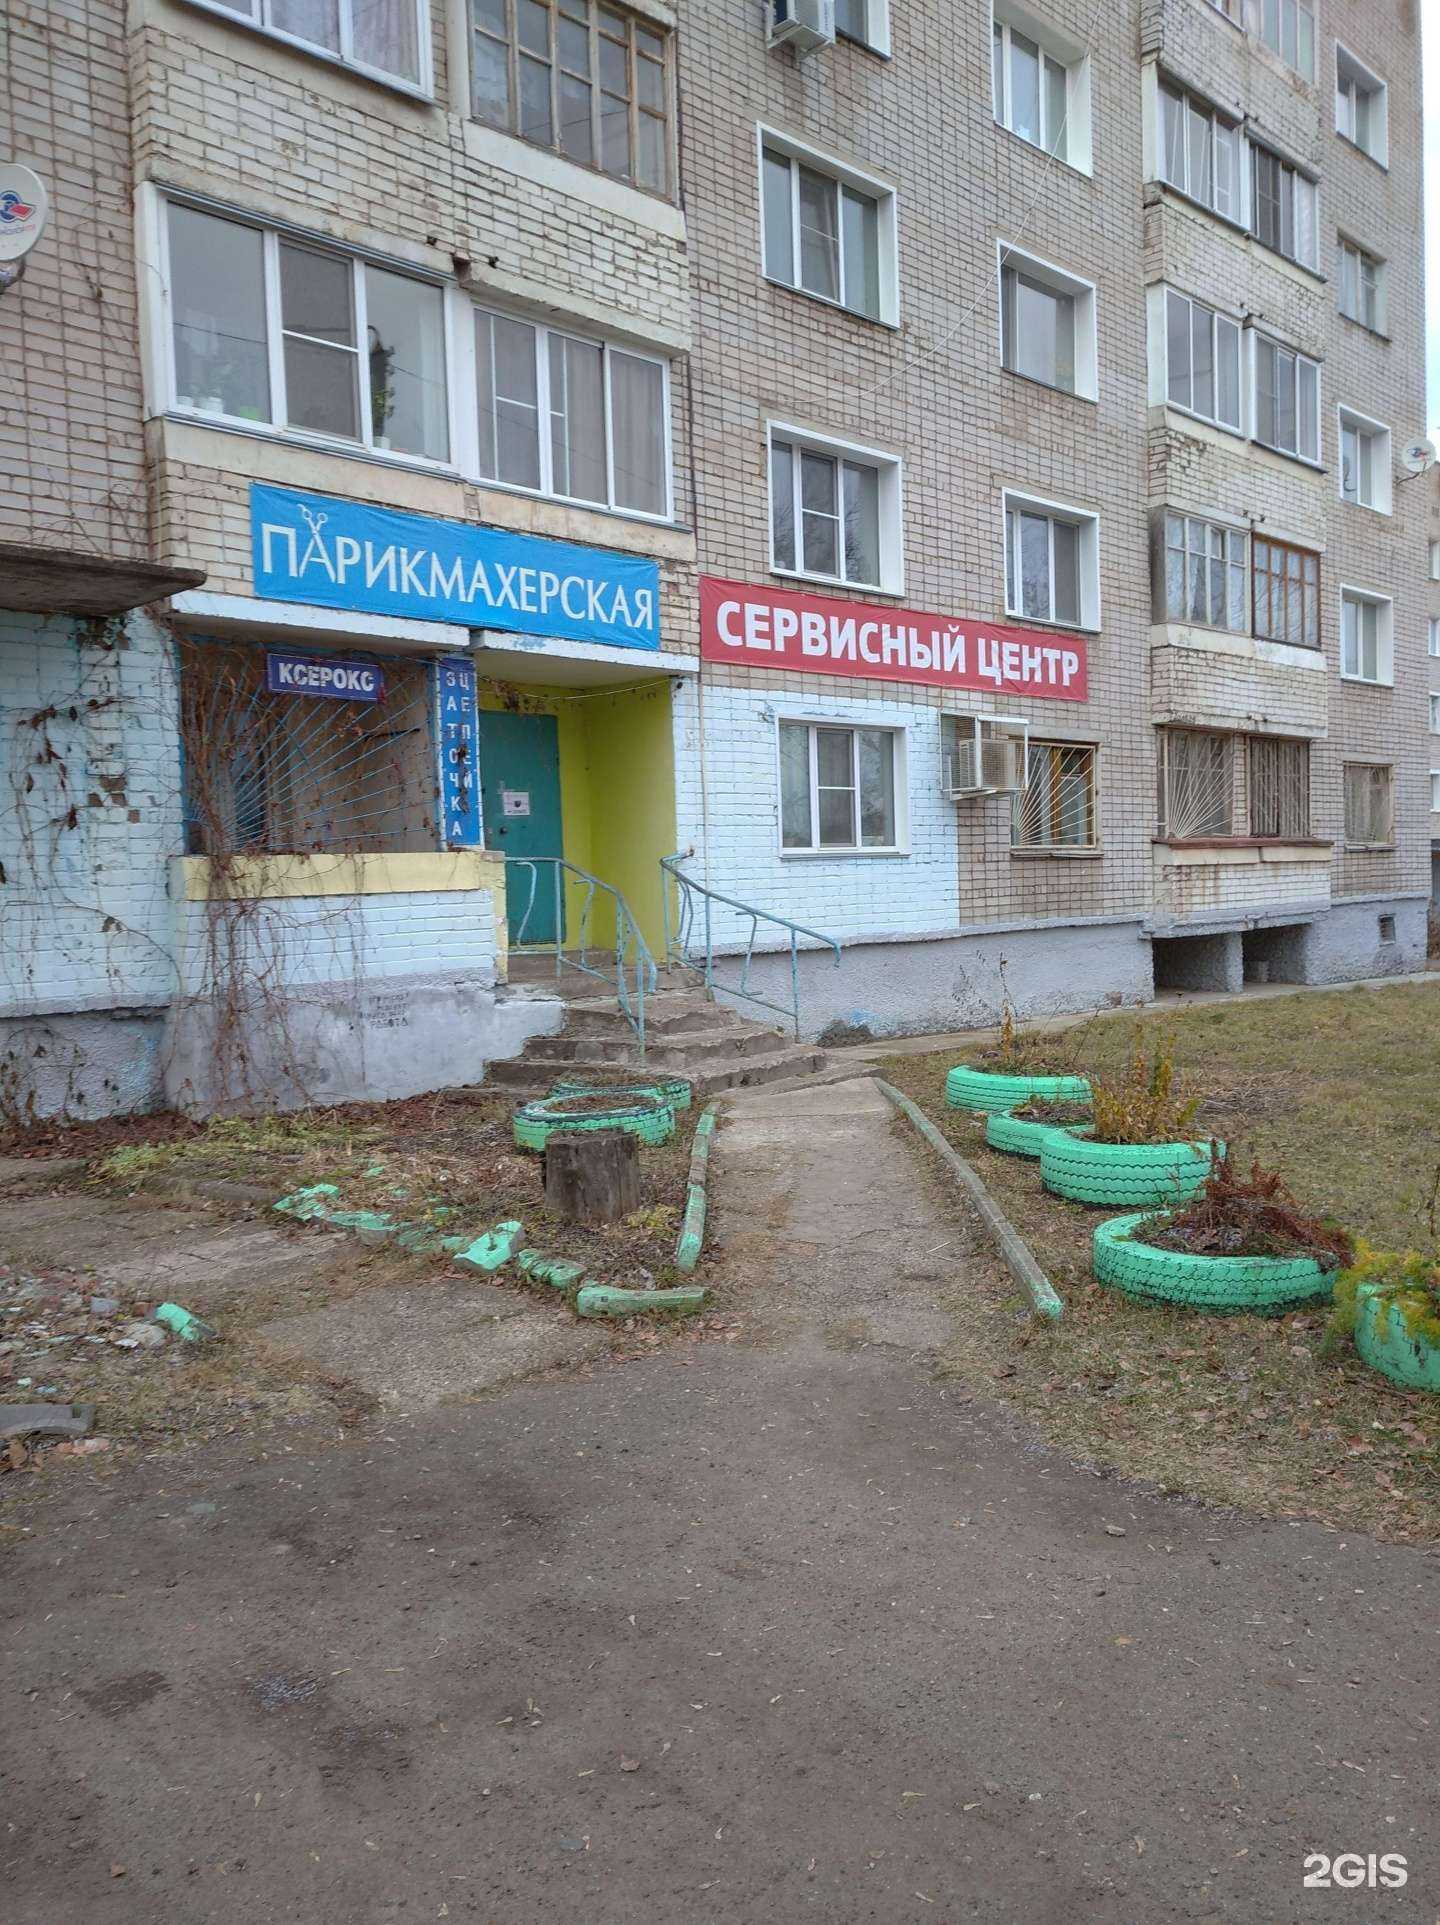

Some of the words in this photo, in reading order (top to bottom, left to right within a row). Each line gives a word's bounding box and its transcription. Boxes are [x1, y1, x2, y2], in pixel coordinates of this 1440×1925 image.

[261, 504, 653, 630] ПАРИКМАХЕРСКАЯ
[278, 662, 374, 692] КСЕРОКС
[716, 600, 966, 673] СЕРВИСНЫЙ
[977, 637, 1079, 687] ЦЕНТР
[446, 671, 463, 836] ЗАТОЧКА
[459, 672, 473, 789] ЦЕПЕЙ
